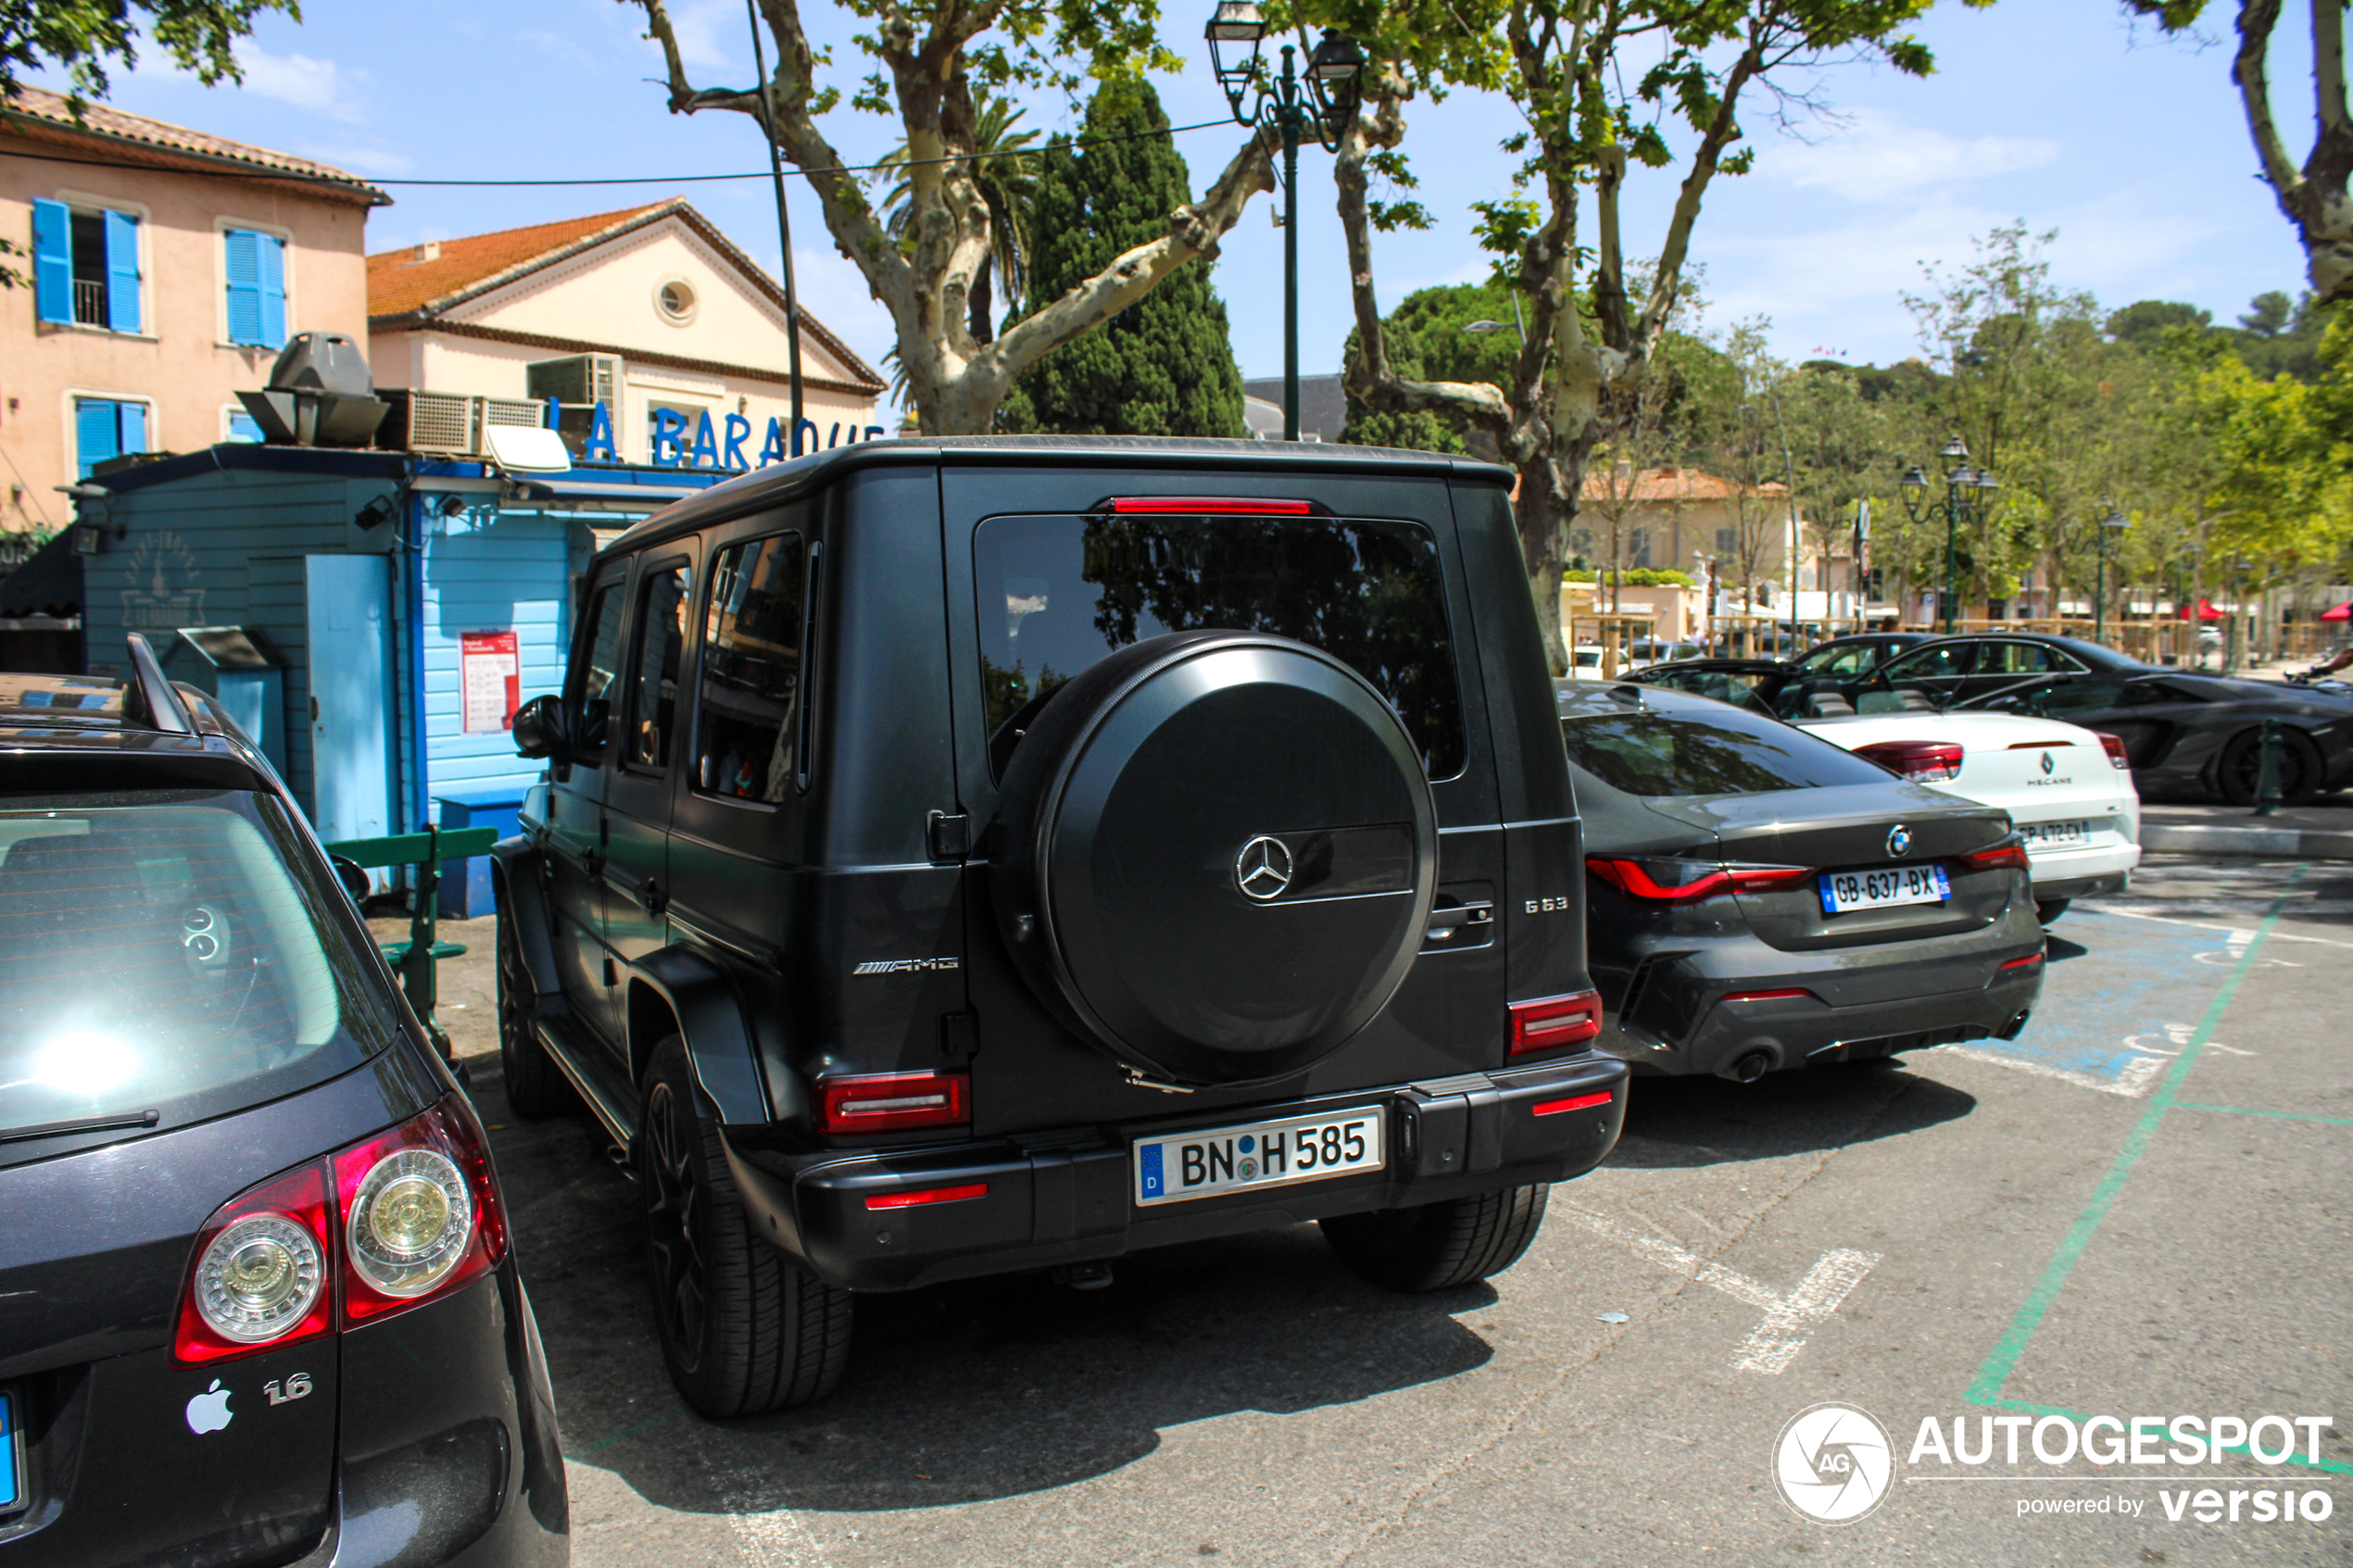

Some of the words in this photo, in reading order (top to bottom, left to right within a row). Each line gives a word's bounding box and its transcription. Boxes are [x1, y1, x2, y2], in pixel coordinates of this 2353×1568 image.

[549, 396, 619, 463] LA
[1835, 869, 1934, 903] GB-637-BX
[887, 957, 959, 973] AMG
[1147, 1177, 1157, 1189] D
